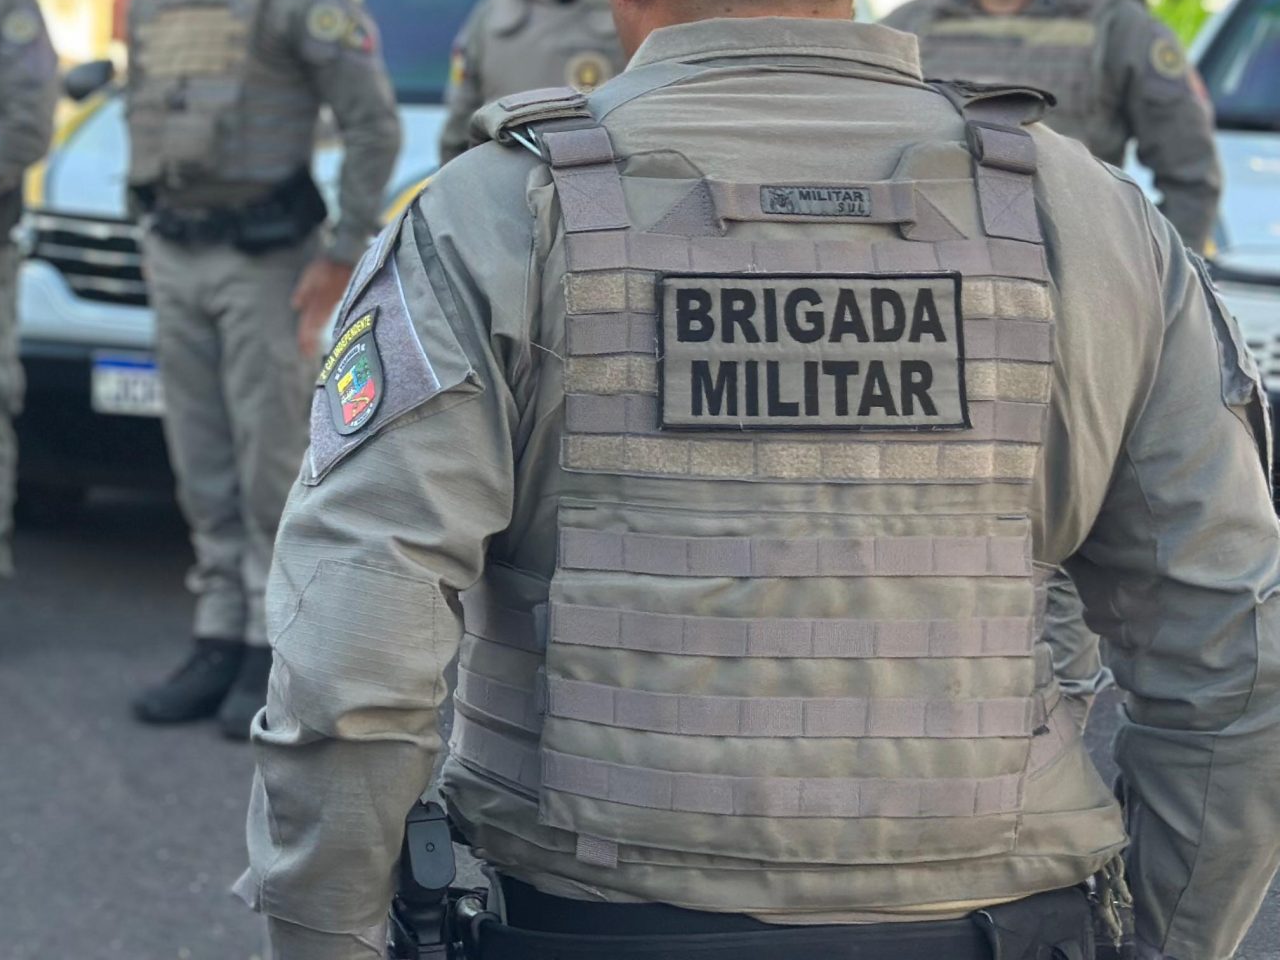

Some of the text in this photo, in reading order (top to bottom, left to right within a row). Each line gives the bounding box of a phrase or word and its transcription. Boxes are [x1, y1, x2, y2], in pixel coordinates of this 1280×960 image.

[799, 190, 864, 203] MILITAR
[837, 202, 865, 214] SUL
[676, 287, 947, 344] BRIGADA
[690, 359, 938, 417] MILITAR
